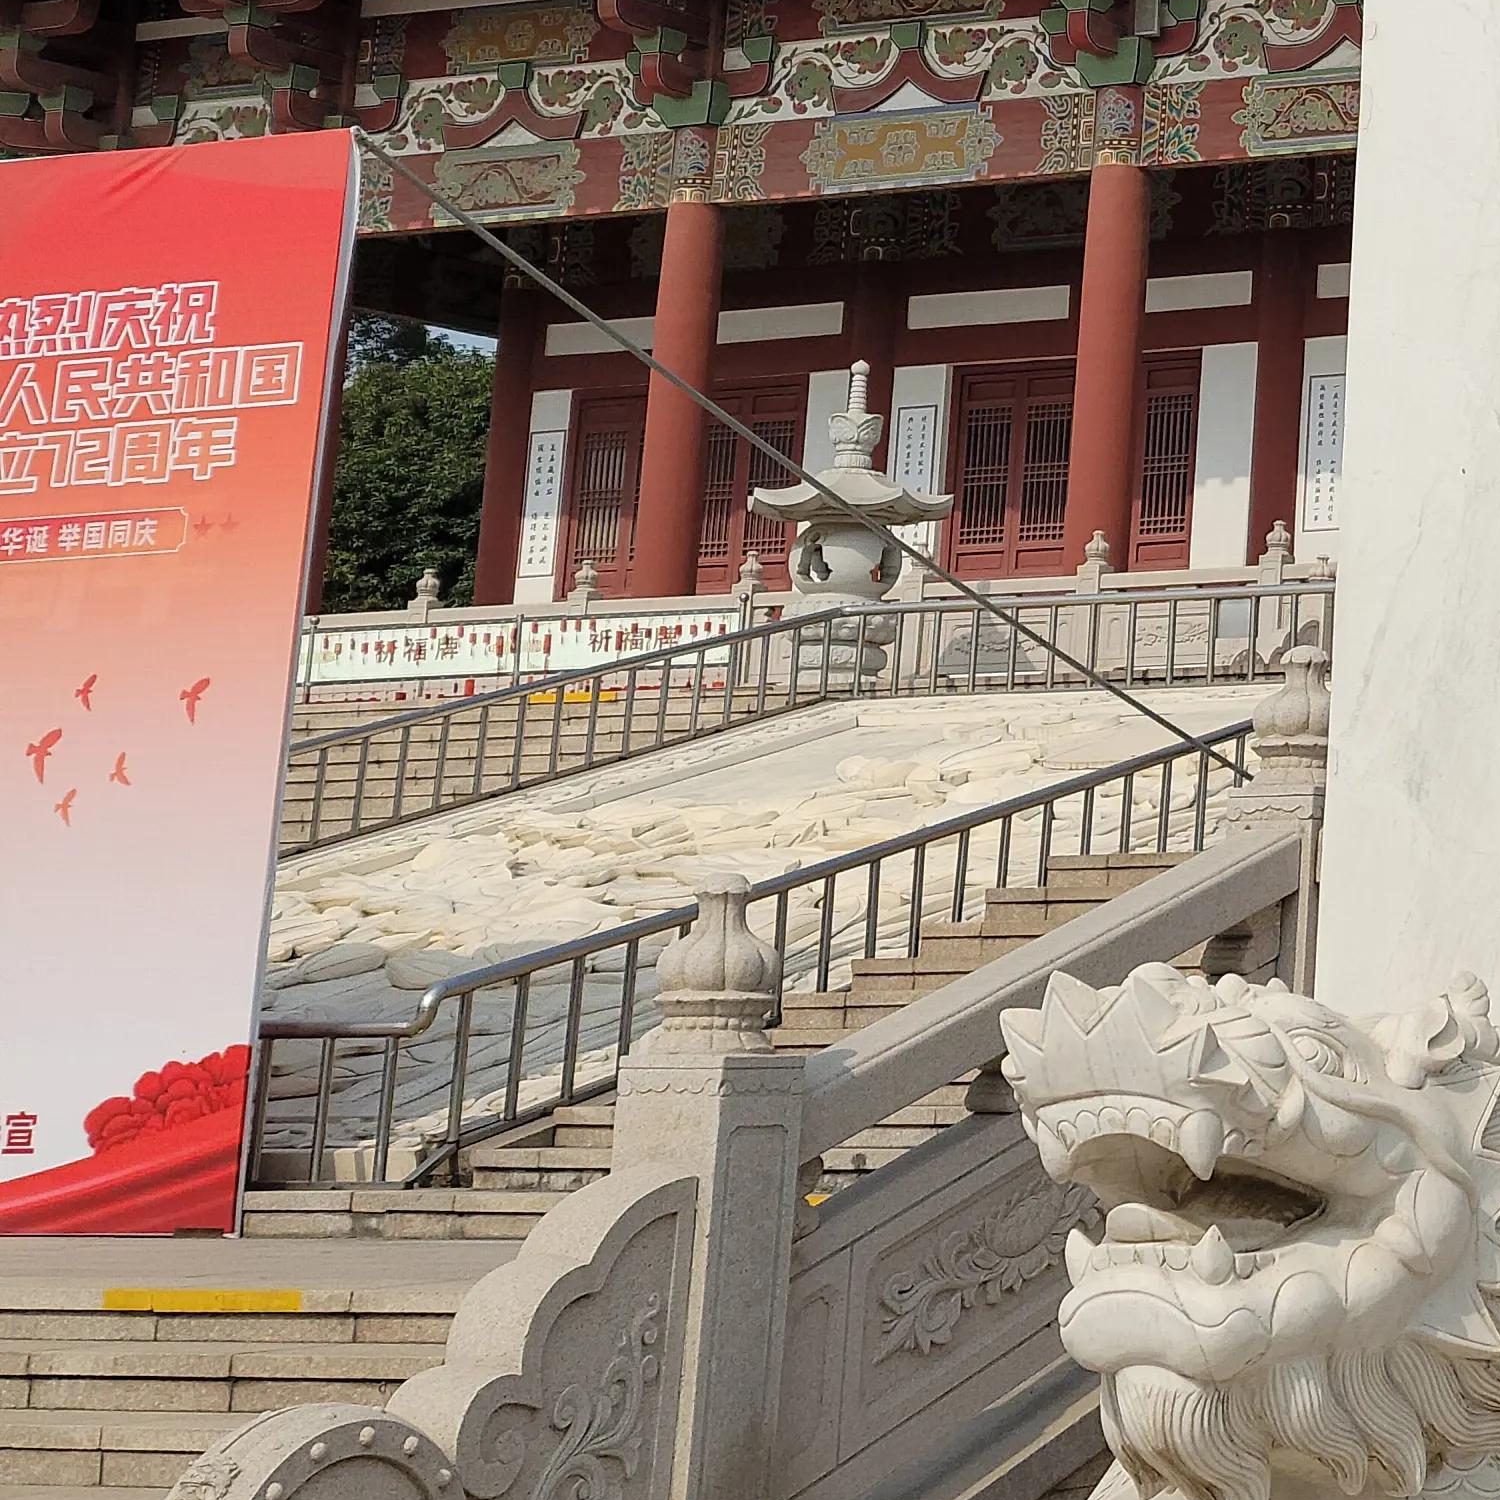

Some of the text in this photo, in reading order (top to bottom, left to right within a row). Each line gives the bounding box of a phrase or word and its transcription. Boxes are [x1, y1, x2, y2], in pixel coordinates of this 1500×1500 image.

[0, 341, 304, 427] 人民共和国
[1, 518, 159, 556] 华诞 举国同庆
[1, 1110, 38, 1155] 宣
